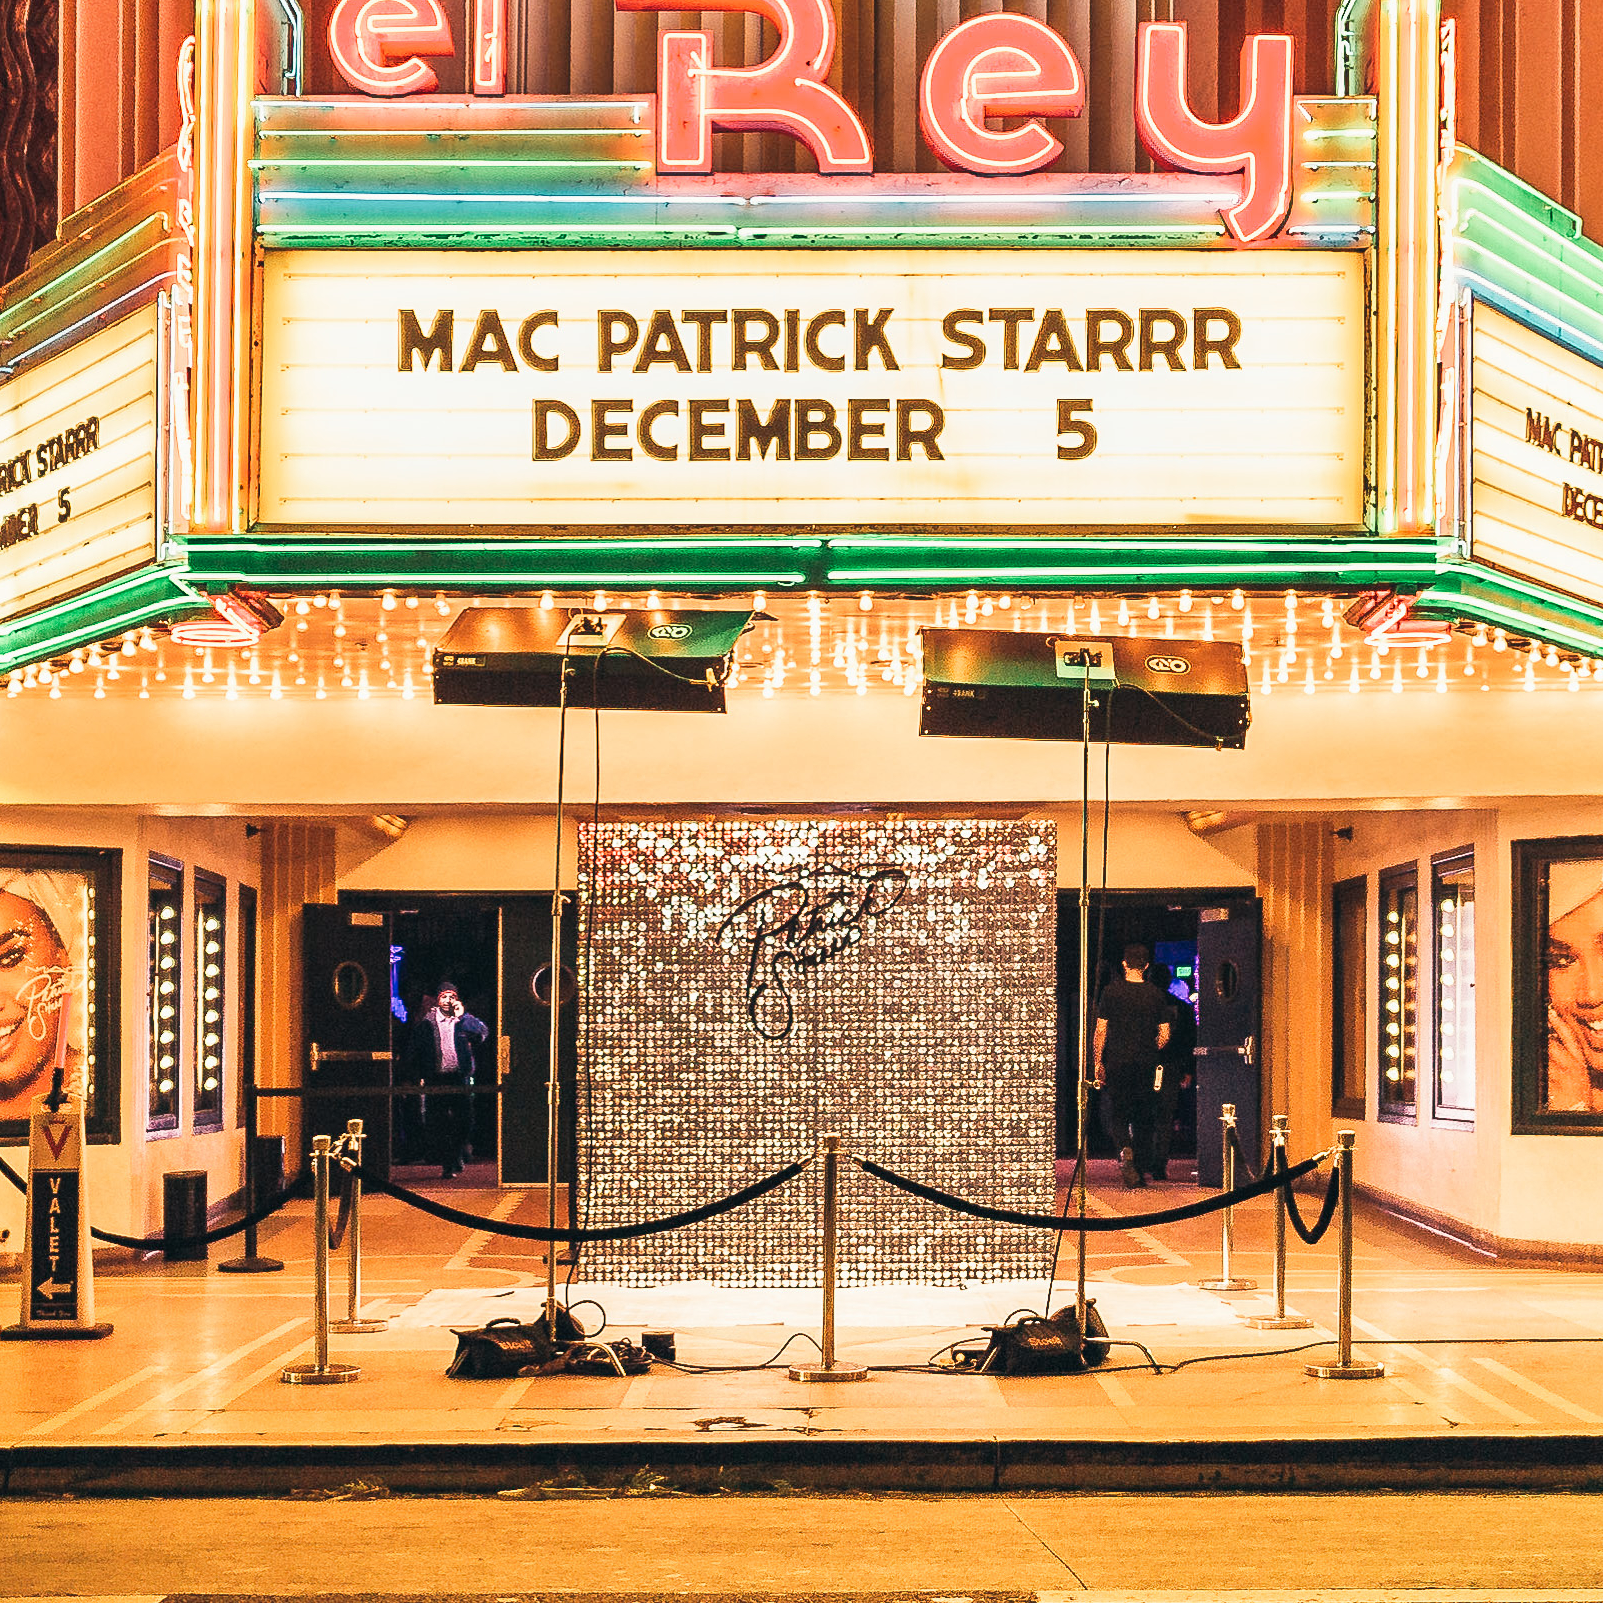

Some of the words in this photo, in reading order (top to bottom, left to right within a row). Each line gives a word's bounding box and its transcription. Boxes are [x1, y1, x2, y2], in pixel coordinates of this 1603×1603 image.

[397, 308, 560, 374] MAC
[597, 307, 901, 374] PATRICK
[942, 306, 1243, 371] STARRR
[35, 416, 100, 479] STARRR
[532, 398, 945, 463] DECEMBER
[1055, 398, 1099, 462] 5
[1526, 407, 1562, 457] MAC
[58, 486, 71, 523] 5
[49, 1177, 61, 1271] VALET
